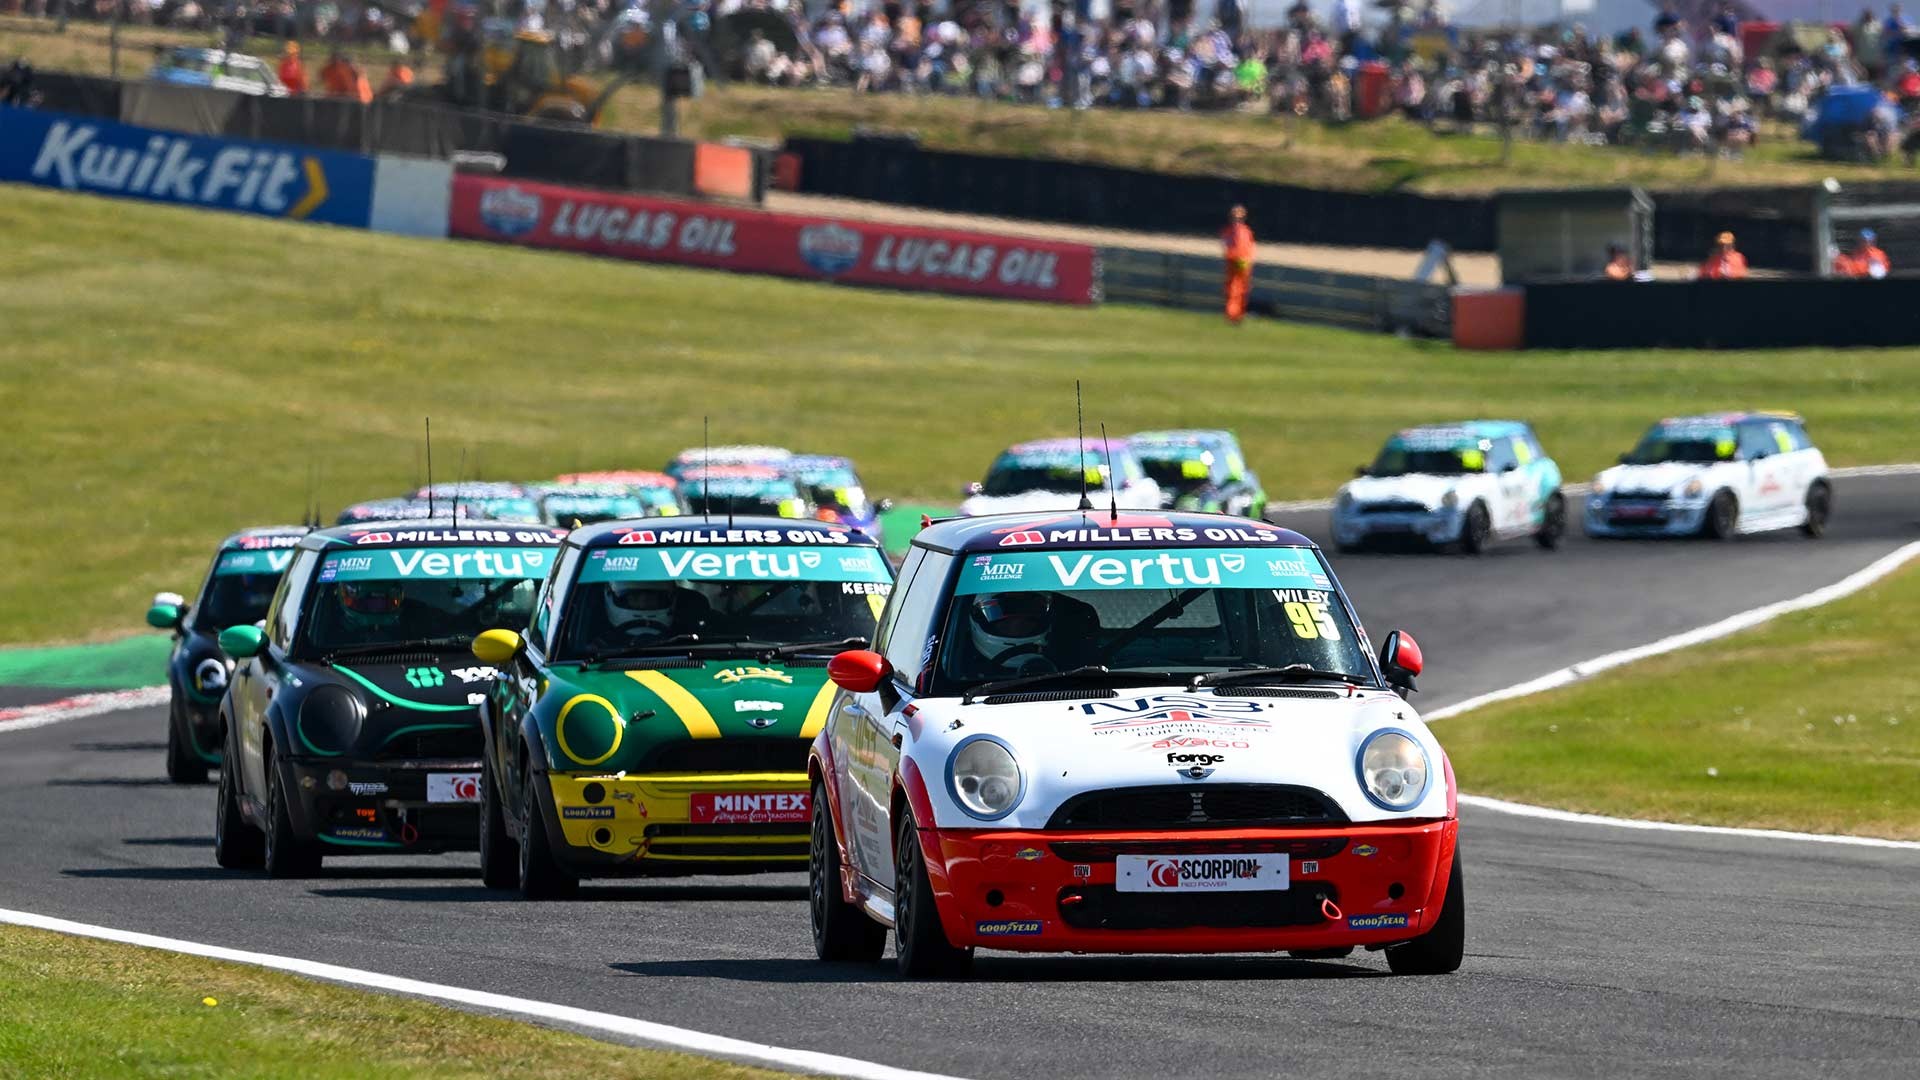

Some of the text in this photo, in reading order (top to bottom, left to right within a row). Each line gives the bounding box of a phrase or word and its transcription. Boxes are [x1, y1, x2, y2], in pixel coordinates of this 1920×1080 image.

[552, 199, 736, 256] LUCAS OIL
[873, 234, 1059, 288] LUCAS OIL
[396, 530, 511, 542] MILLERS
[660, 530, 849, 544] MILLERS OILS
[1050, 527, 1279, 542] MILLERS OILS
[340, 557, 372, 568] MINI
[390, 550, 524, 576] Vertu
[604, 557, 640, 568] MINI
[658, 550, 800, 578] Vertu
[982, 563, 1025, 575] MINI
[1265, 560, 1307, 572] MINI
[1048, 554, 1221, 587] Vertu
[1272, 589, 1331, 606] WILBY
[1284, 602, 1341, 641] 95
[1167, 752, 1225, 766] Forge
[714, 794, 806, 811] MINTEX
[1181, 859, 1257, 879] SCORPION
[979, 922, 1038, 933] GOODYEAR
[1352, 914, 1405, 927] GOODYEAR
